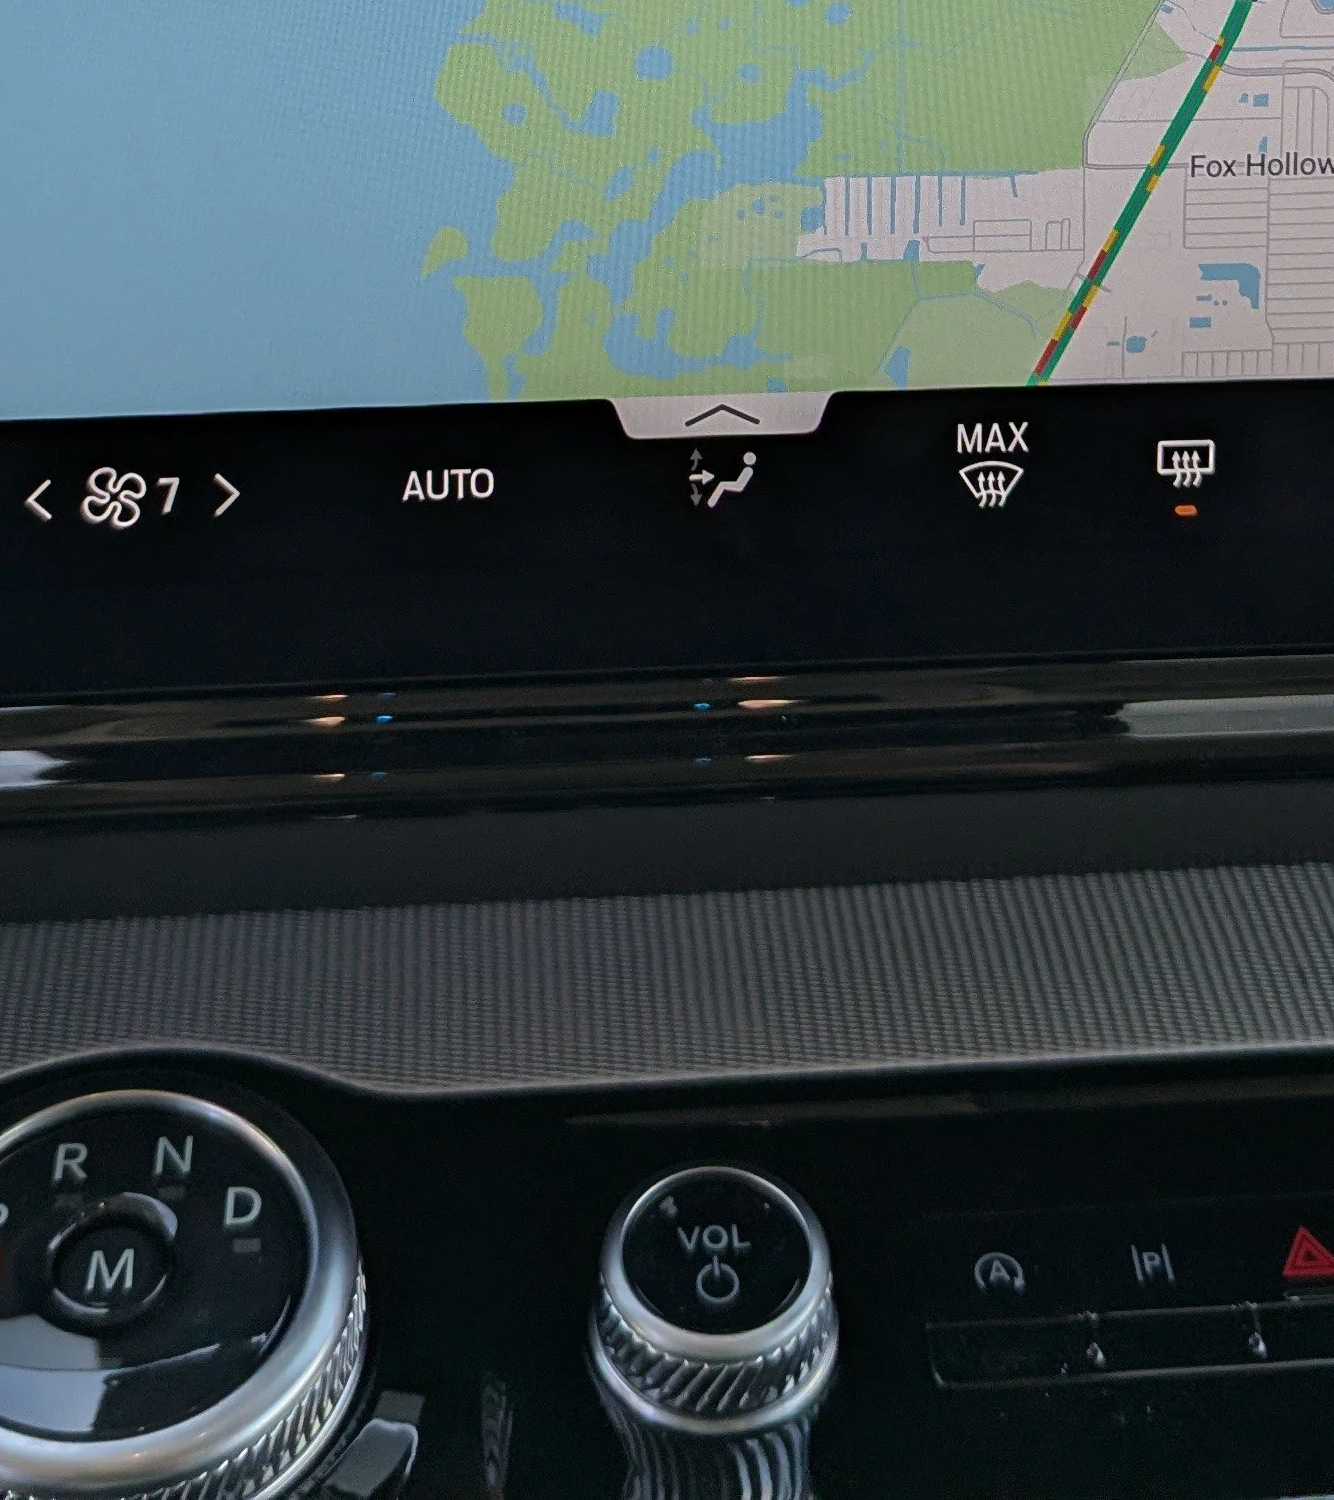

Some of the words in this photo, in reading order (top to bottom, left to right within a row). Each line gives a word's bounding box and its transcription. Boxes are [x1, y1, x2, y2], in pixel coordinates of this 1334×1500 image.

[1189, 154, 1238, 179] Fox
[955, 420, 1030, 456] MAX
[155, 476, 181, 514] 7
[401, 467, 496, 504] AUTO
[52, 1142, 88, 1182] R
[152, 1134, 195, 1178] N
[222, 1185, 264, 1228] D
[676, 1222, 752, 1252] VOL
[84, 1247, 136, 1293] M
